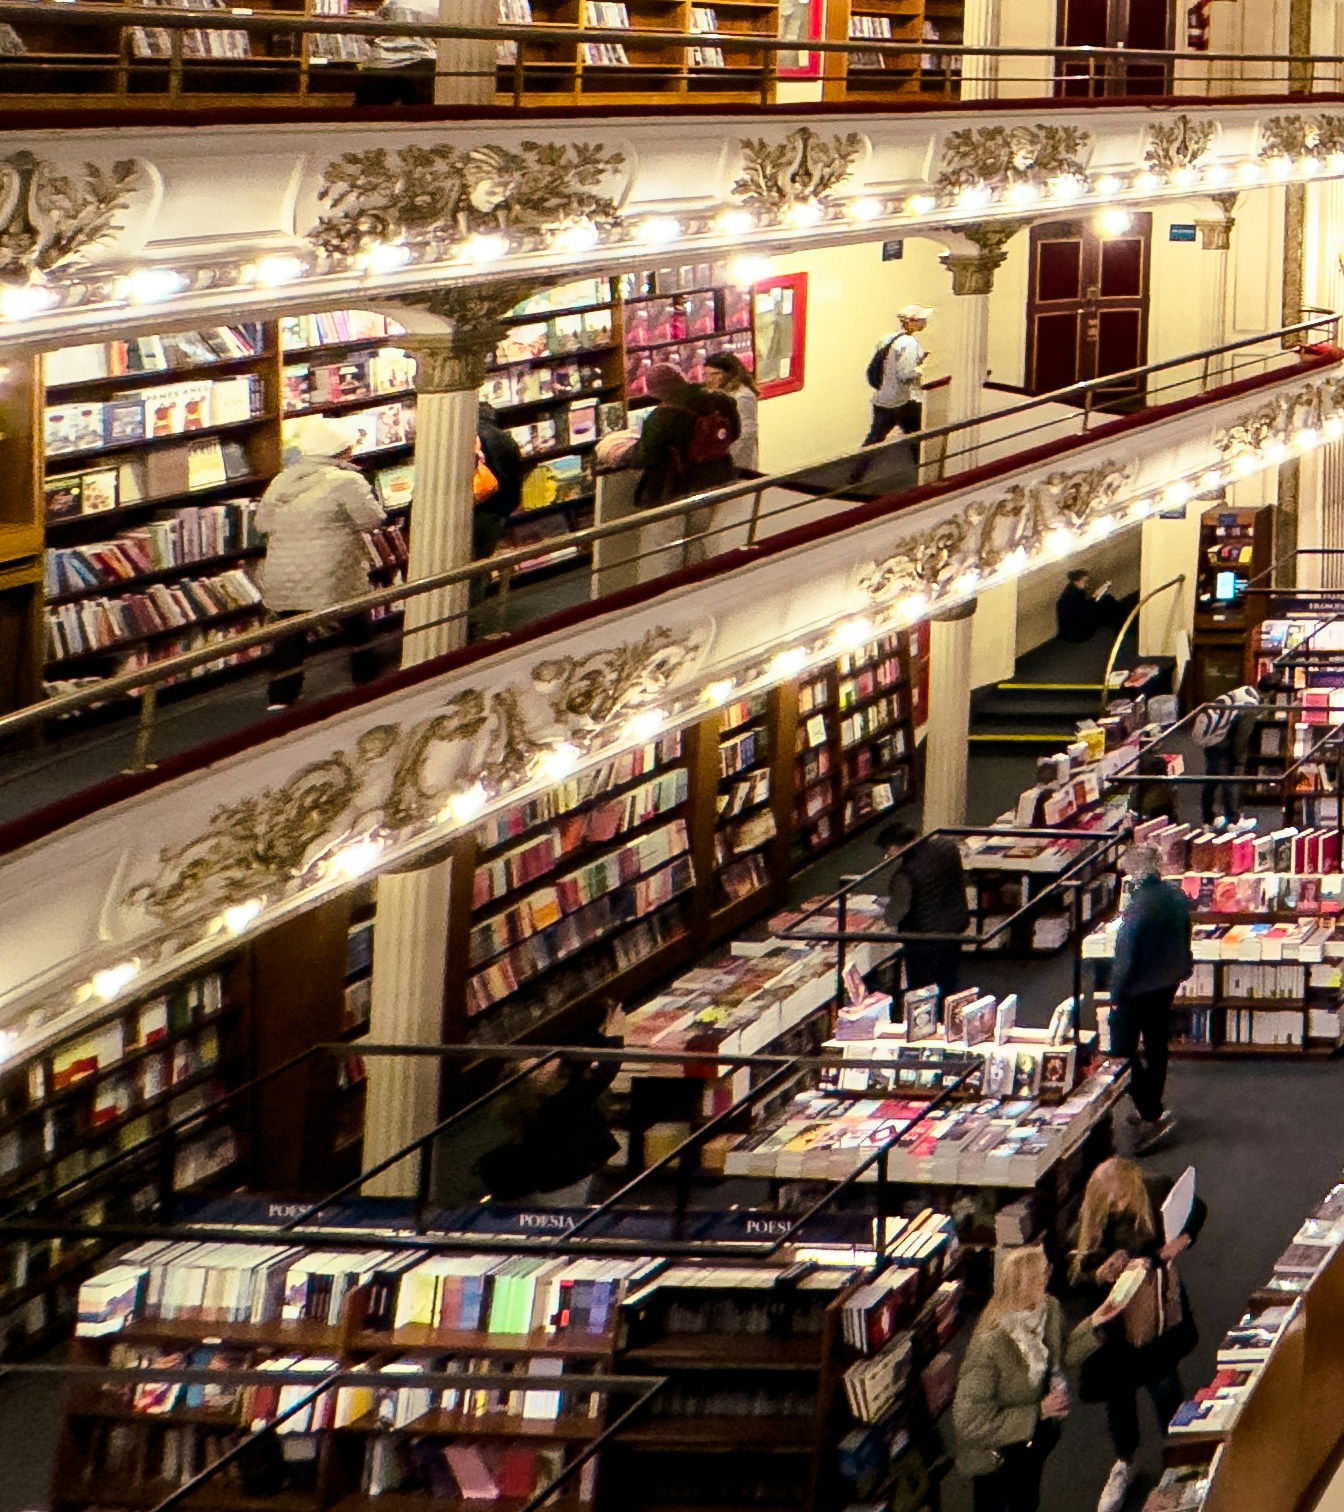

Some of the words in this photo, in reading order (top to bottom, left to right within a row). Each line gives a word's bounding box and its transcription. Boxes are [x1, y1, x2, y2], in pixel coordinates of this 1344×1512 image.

[268, 1204, 323, 1220] POES
[519, 1214, 576, 1230] POESIA
[746, 1220, 802, 1236] POESI
